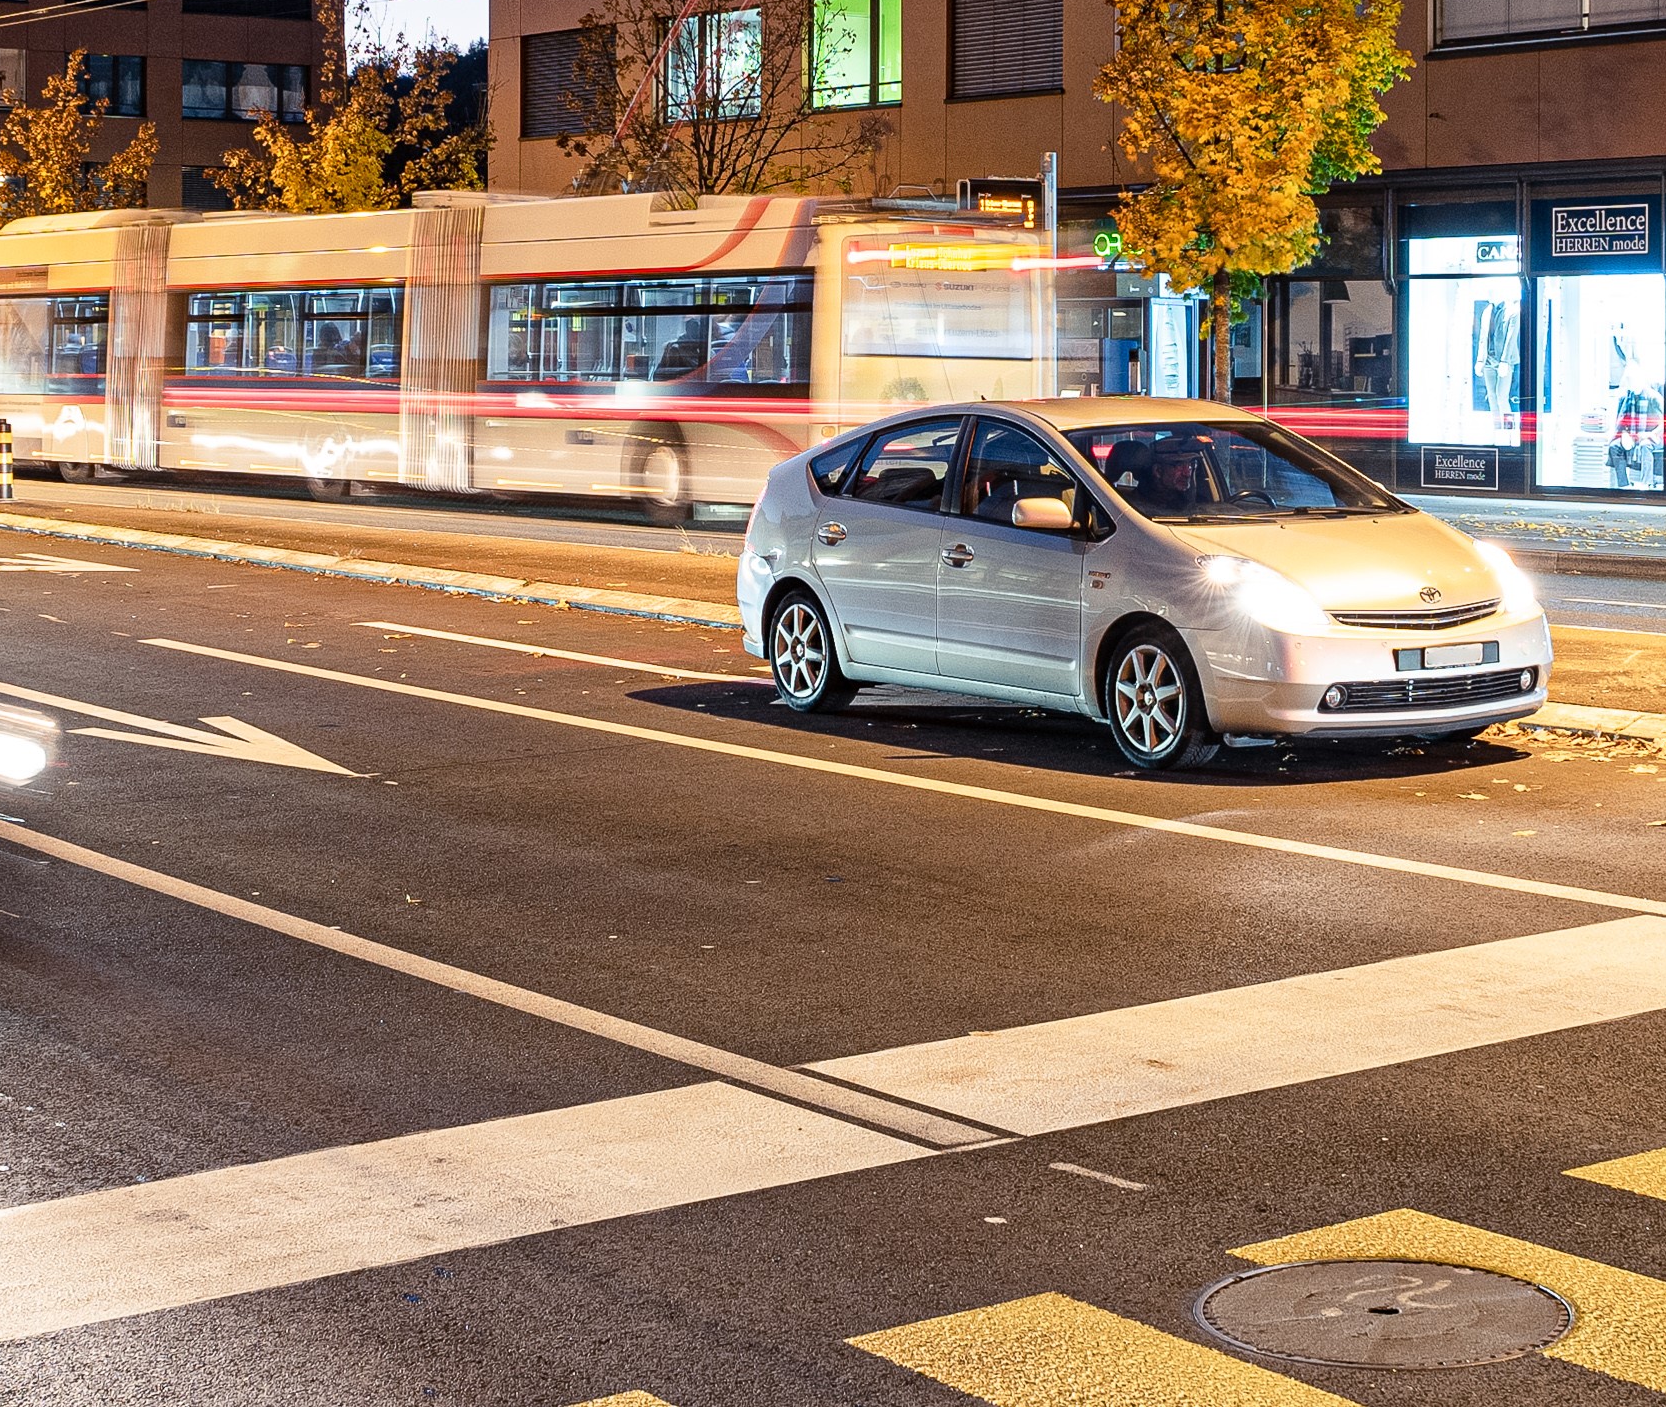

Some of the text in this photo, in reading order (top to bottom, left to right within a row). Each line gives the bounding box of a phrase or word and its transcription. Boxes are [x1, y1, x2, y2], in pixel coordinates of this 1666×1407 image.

[1556, 210, 1645, 233] Excellence
[1556, 235, 1645, 252] HERREN mode
[1435, 455, 1486, 469] Excellence
[1435, 469, 1486, 481] HERREN mode
